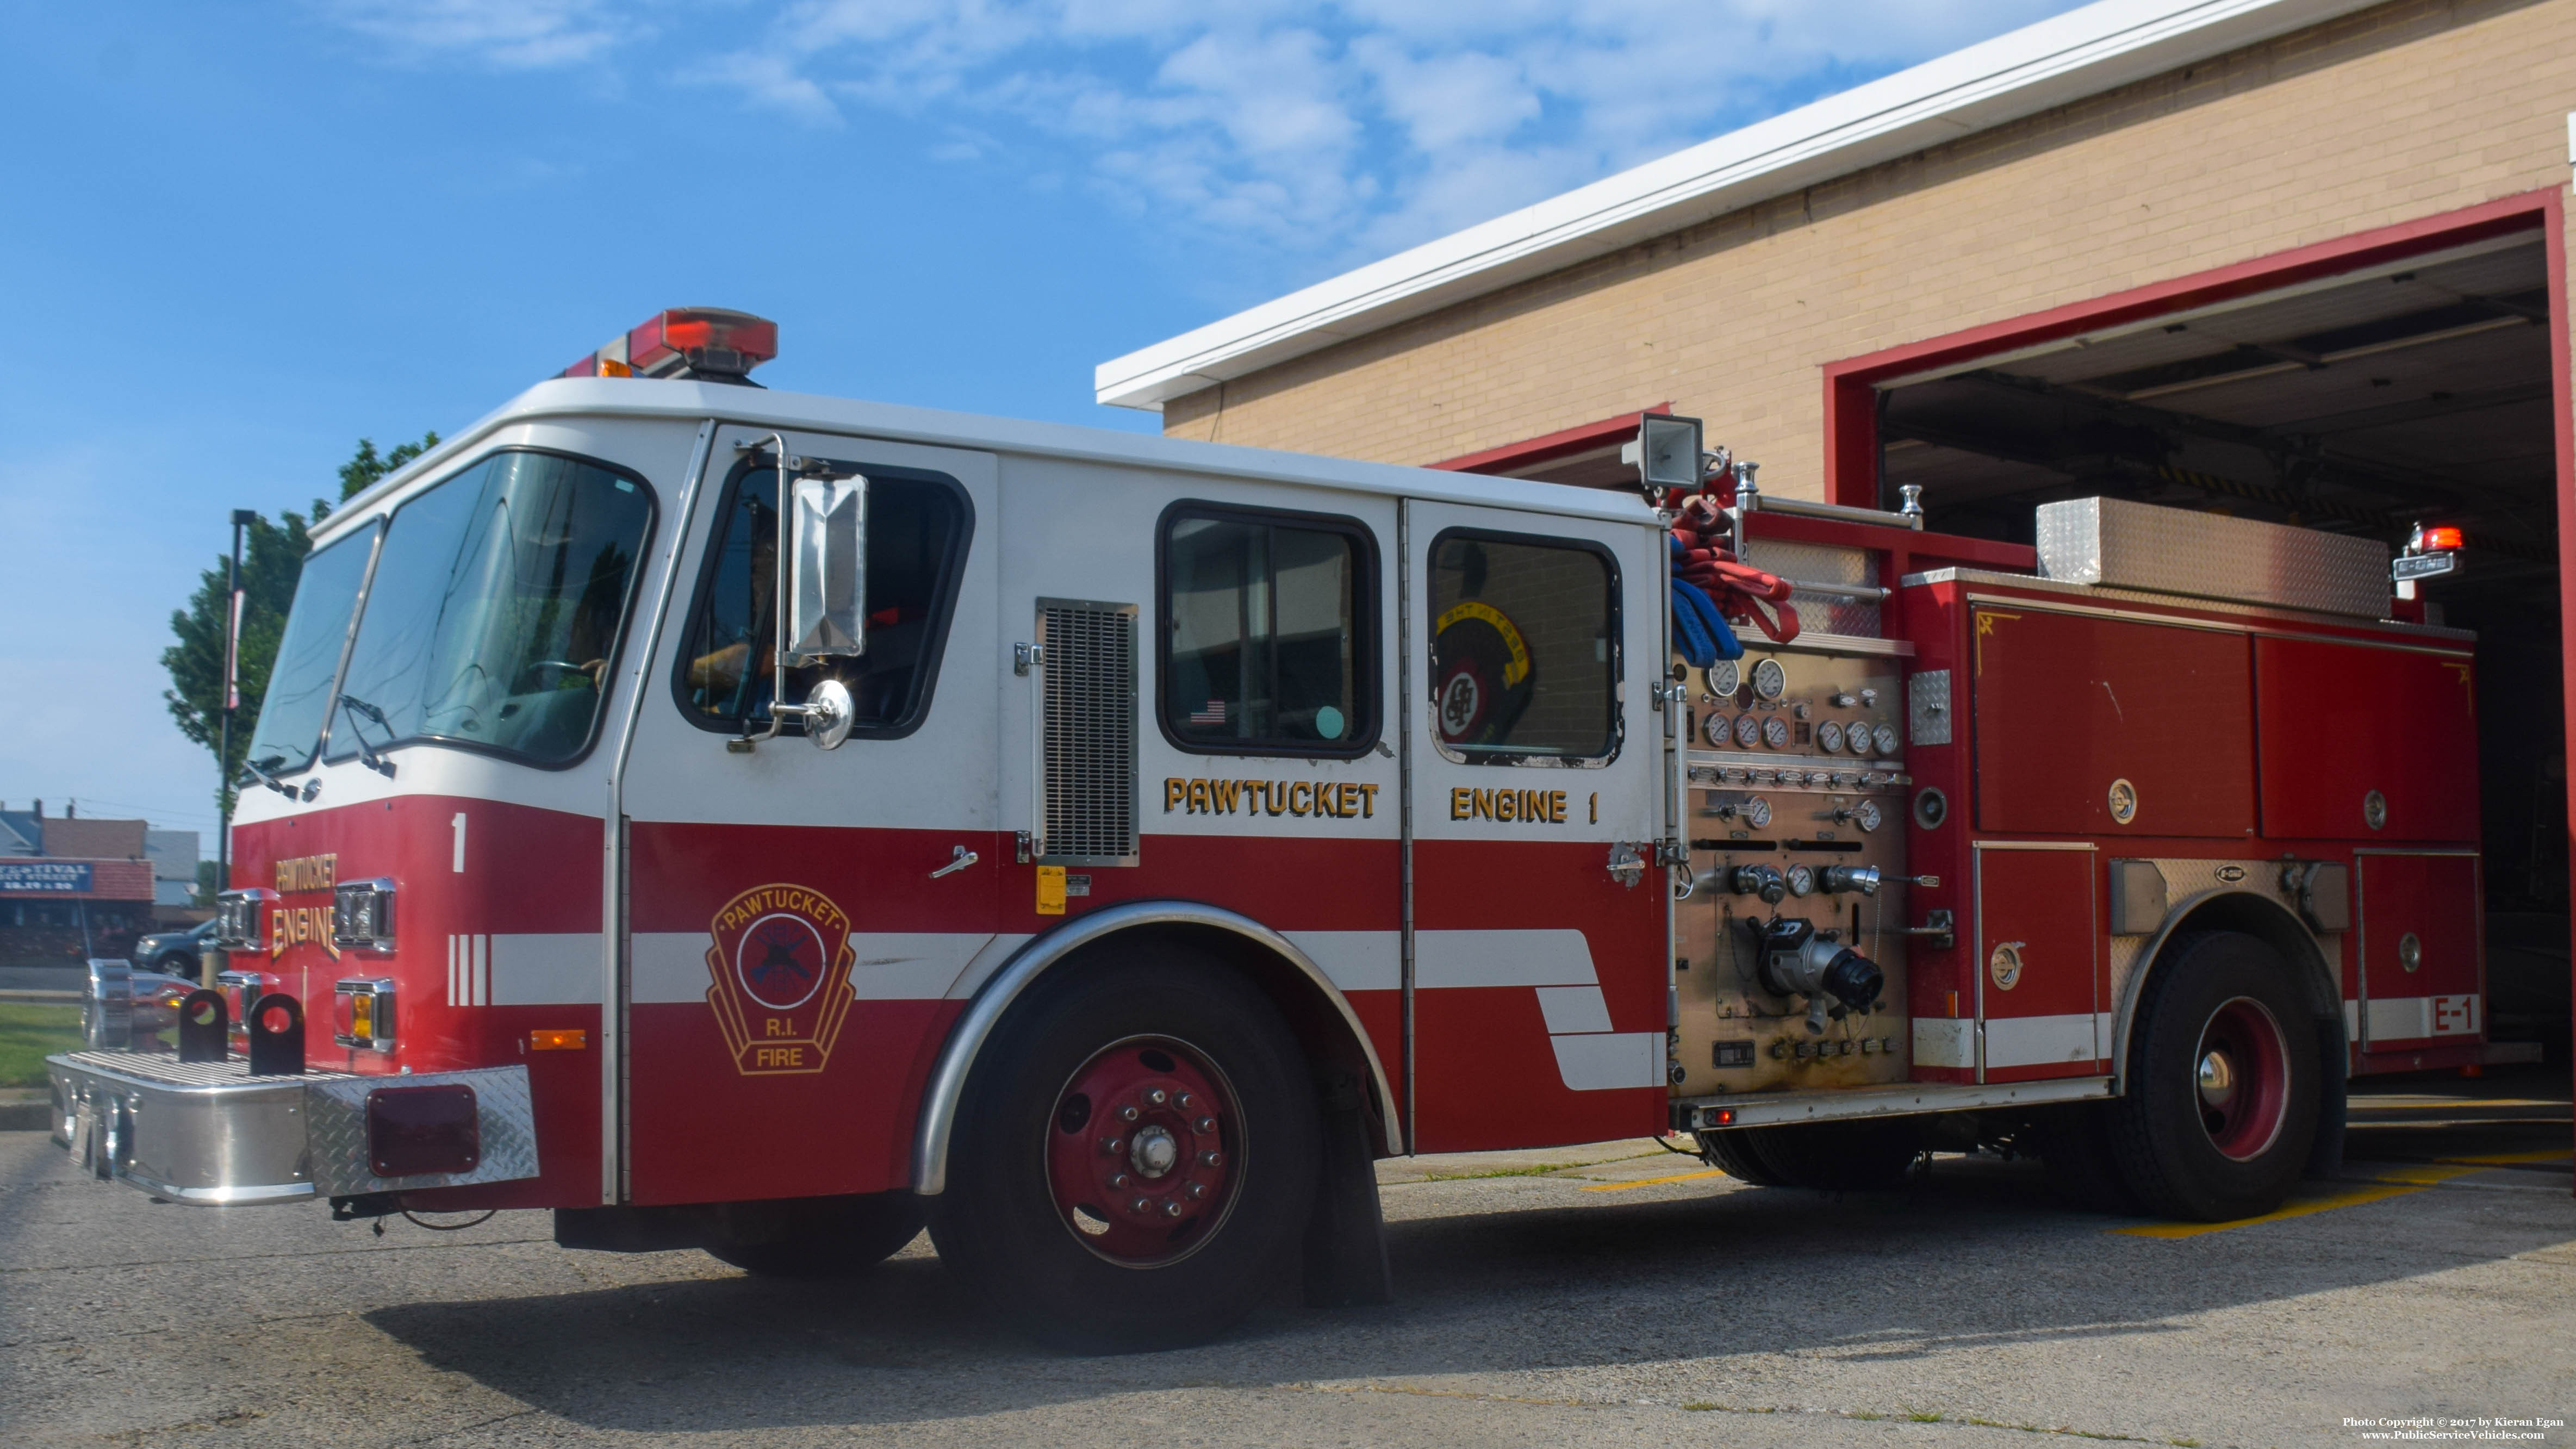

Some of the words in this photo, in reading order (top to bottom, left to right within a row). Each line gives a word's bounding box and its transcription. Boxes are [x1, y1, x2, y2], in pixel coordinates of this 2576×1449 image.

[2399, 558, 2447, 571] E-ONE
[1163, 778, 1379, 818] PAWTUCKET
[1451, 787, 1567, 823] ENGINE
[1589, 792, 1598, 824] 1
[452, 812, 466, 873] 1
[276, 853, 337, 892] PAWTUCKET
[723, 890, 840, 930] PAWTUCKET
[273, 906, 341, 960] ENGINE
[766, 1018, 797, 1036] R.I.
[2436, 996, 2472, 1031] E-1
[756, 1047, 803, 1067] FIRE
